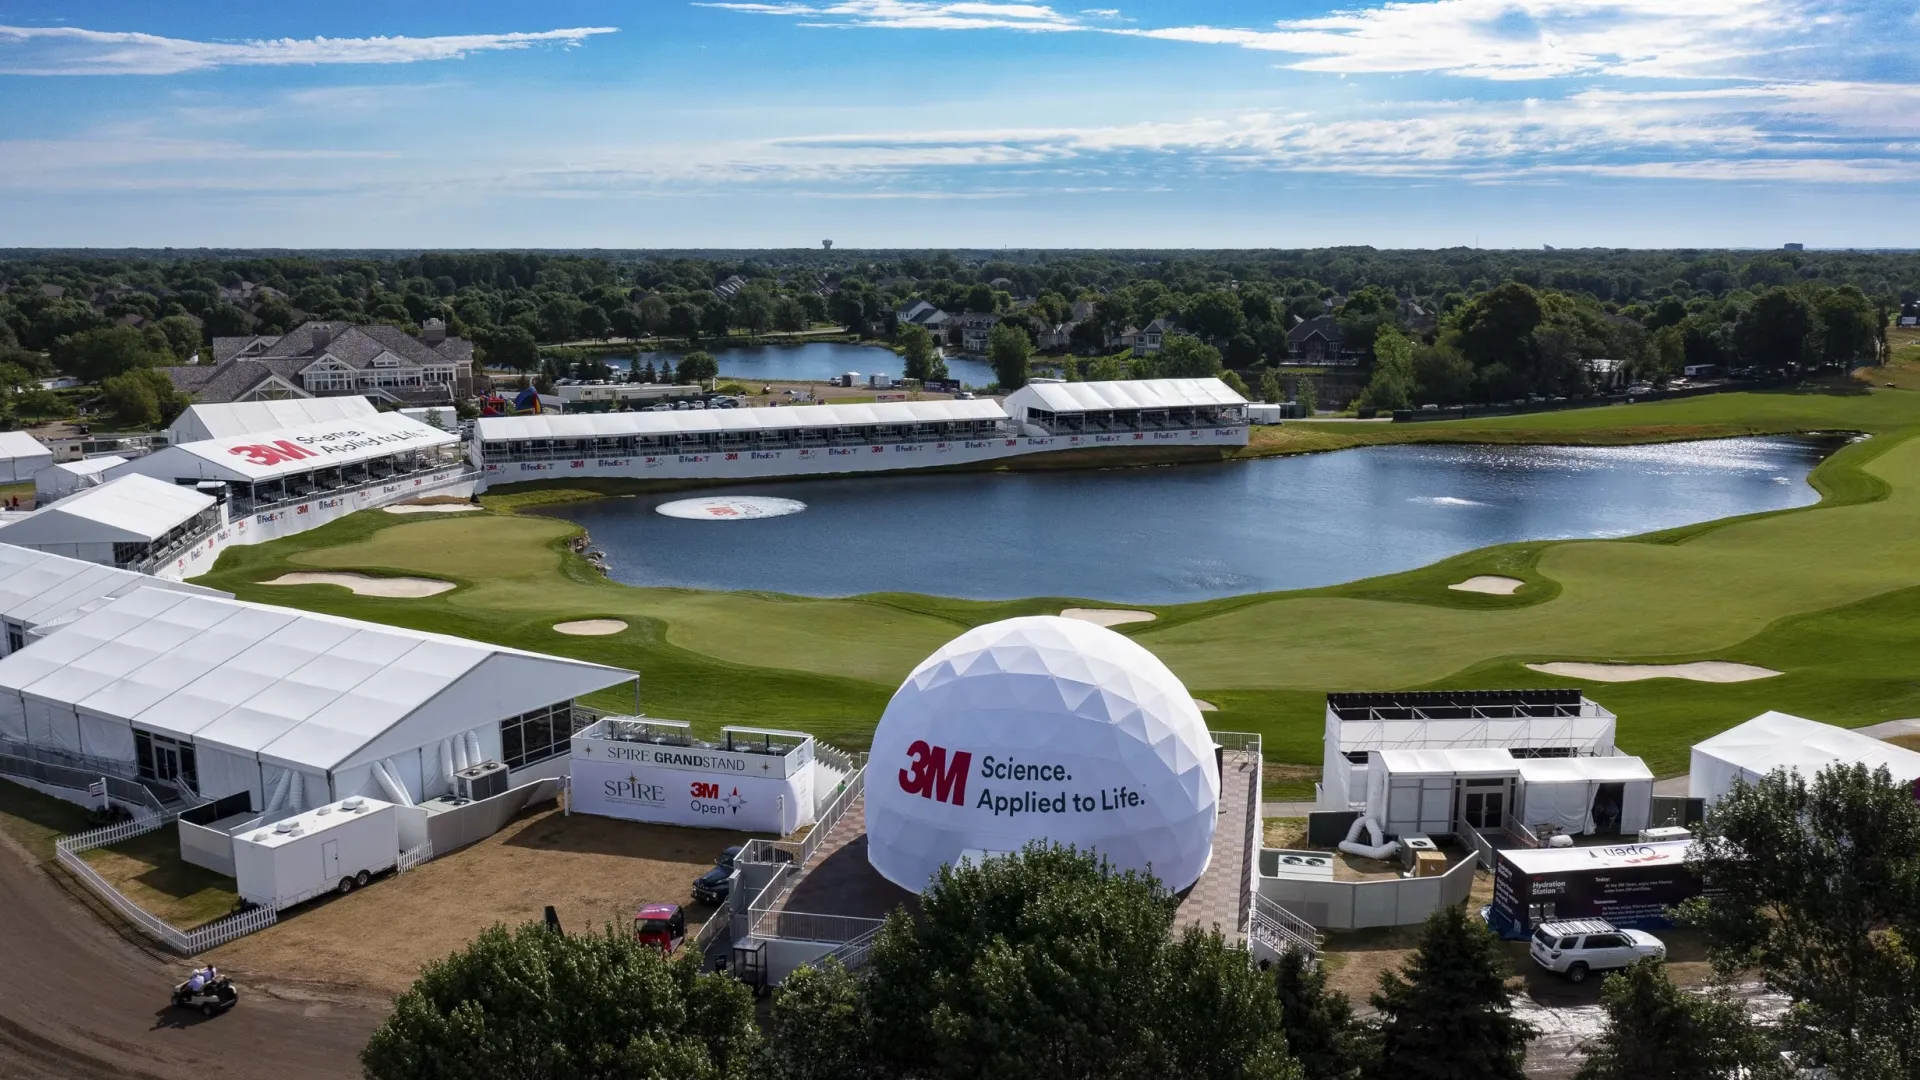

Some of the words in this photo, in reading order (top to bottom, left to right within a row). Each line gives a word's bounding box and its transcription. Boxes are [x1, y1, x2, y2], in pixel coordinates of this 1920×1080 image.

[296, 430, 366, 444] Science.
[1005, 439, 1016, 447] 3M
[227, 440, 320, 466] 3M
[320, 437, 382, 454] Applied
[570, 460, 584, 468] 3M
[296, 504, 309, 515] 3M
[323, 500, 339, 509] FedEx
[607, 746, 650, 762] SPIRE
[654, 752, 745, 771] GRANDSTAND
[898, 740, 972, 806] 3M
[981, 755, 1072, 781] Science.
[604, 780, 666, 801] SPIRE
[690, 782, 719, 799] 3M
[691, 800, 725, 815] Open
[976, 788, 1066, 817] Applied
[1072, 793, 1095, 812] to
[1101, 786, 1145, 811] Life.
[1603, 845, 1656, 856] Open
[1532, 881, 1566, 889] Hydration
